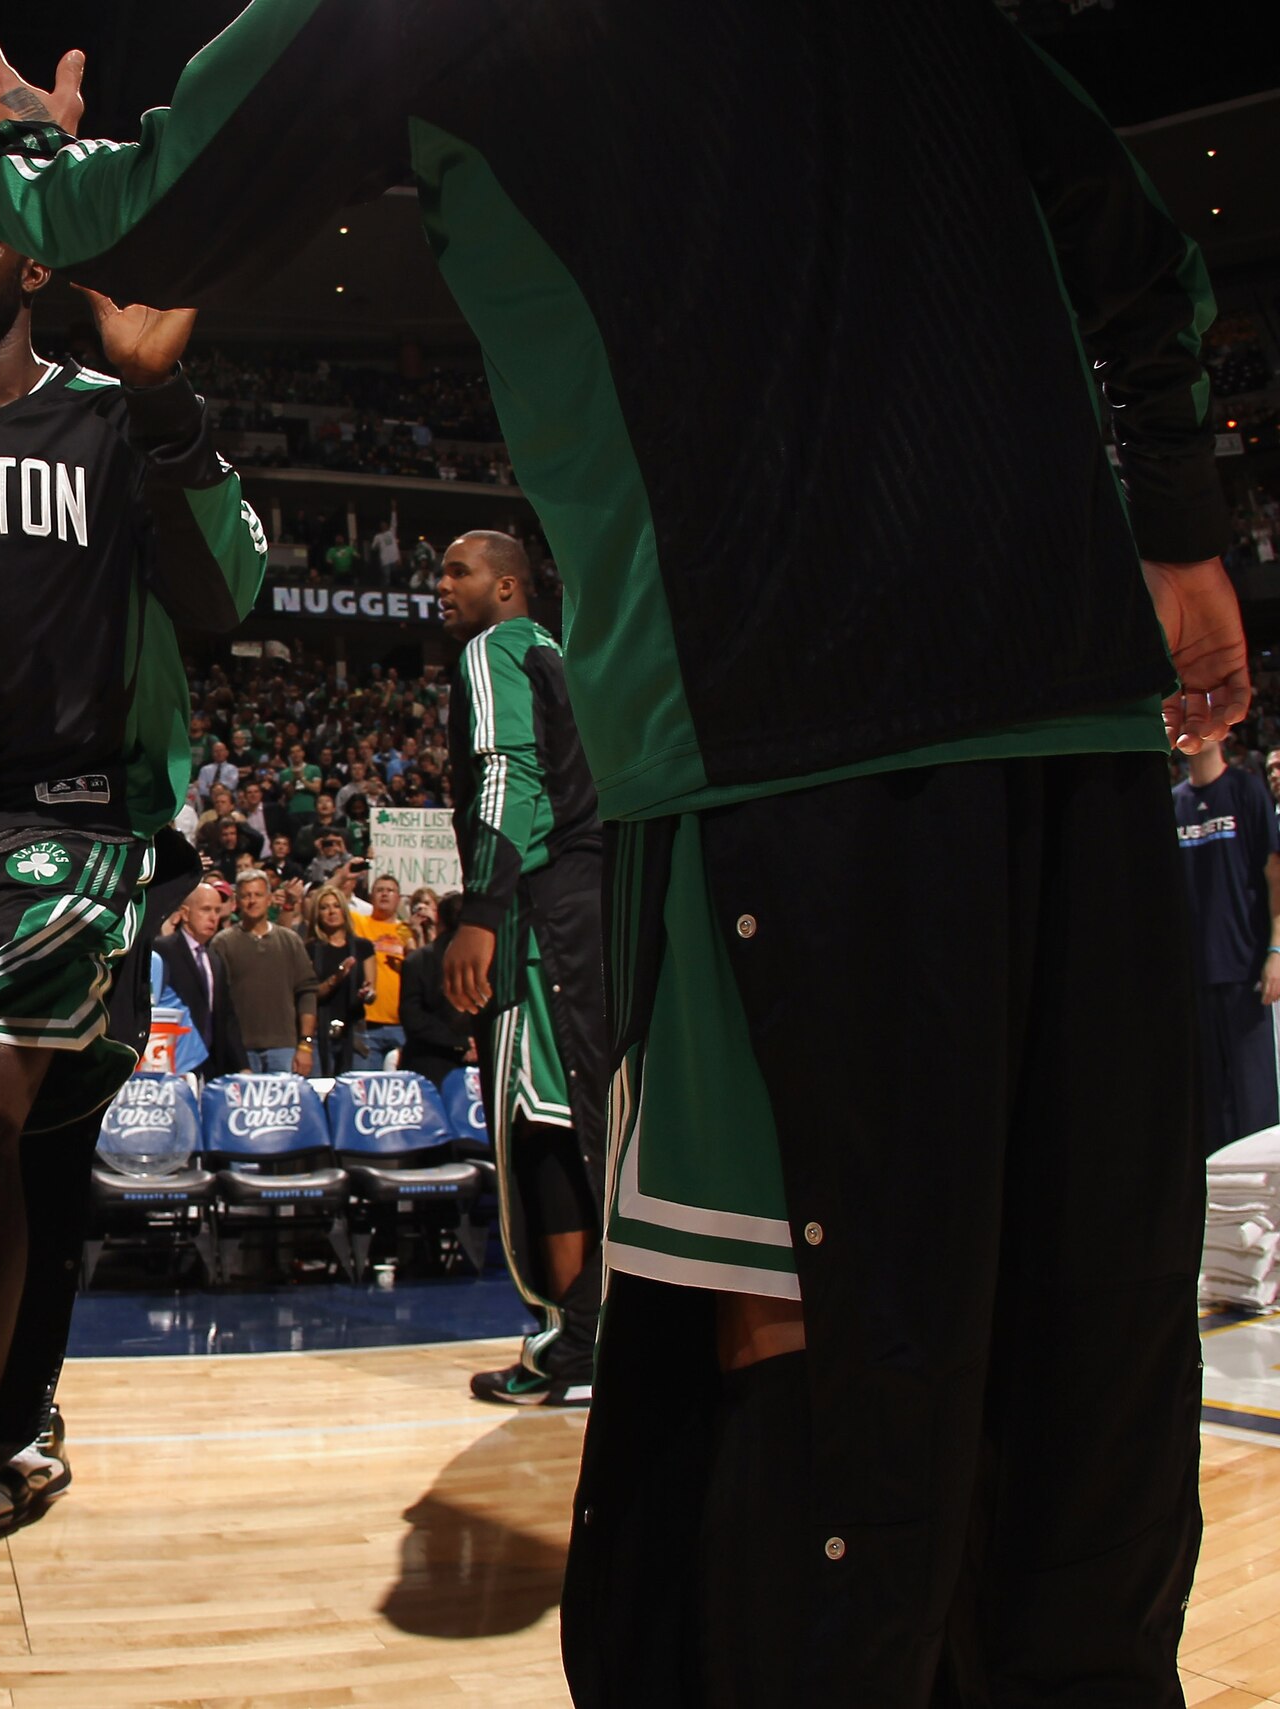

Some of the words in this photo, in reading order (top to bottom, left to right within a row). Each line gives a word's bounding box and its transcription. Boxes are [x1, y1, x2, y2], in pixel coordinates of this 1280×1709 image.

[389, 811, 421, 828] WISH
[424, 811, 455, 829] LIST
[12, 842, 70, 863] CELTICS
[374, 855, 448, 885] BANNER
[117, 1078, 176, 1106] NBA
[242, 1080, 301, 1108] NBA
[367, 1078, 423, 1106] NBA
[227, 1105, 302, 1137] Cares
[354, 1105, 424, 1135] Cares
